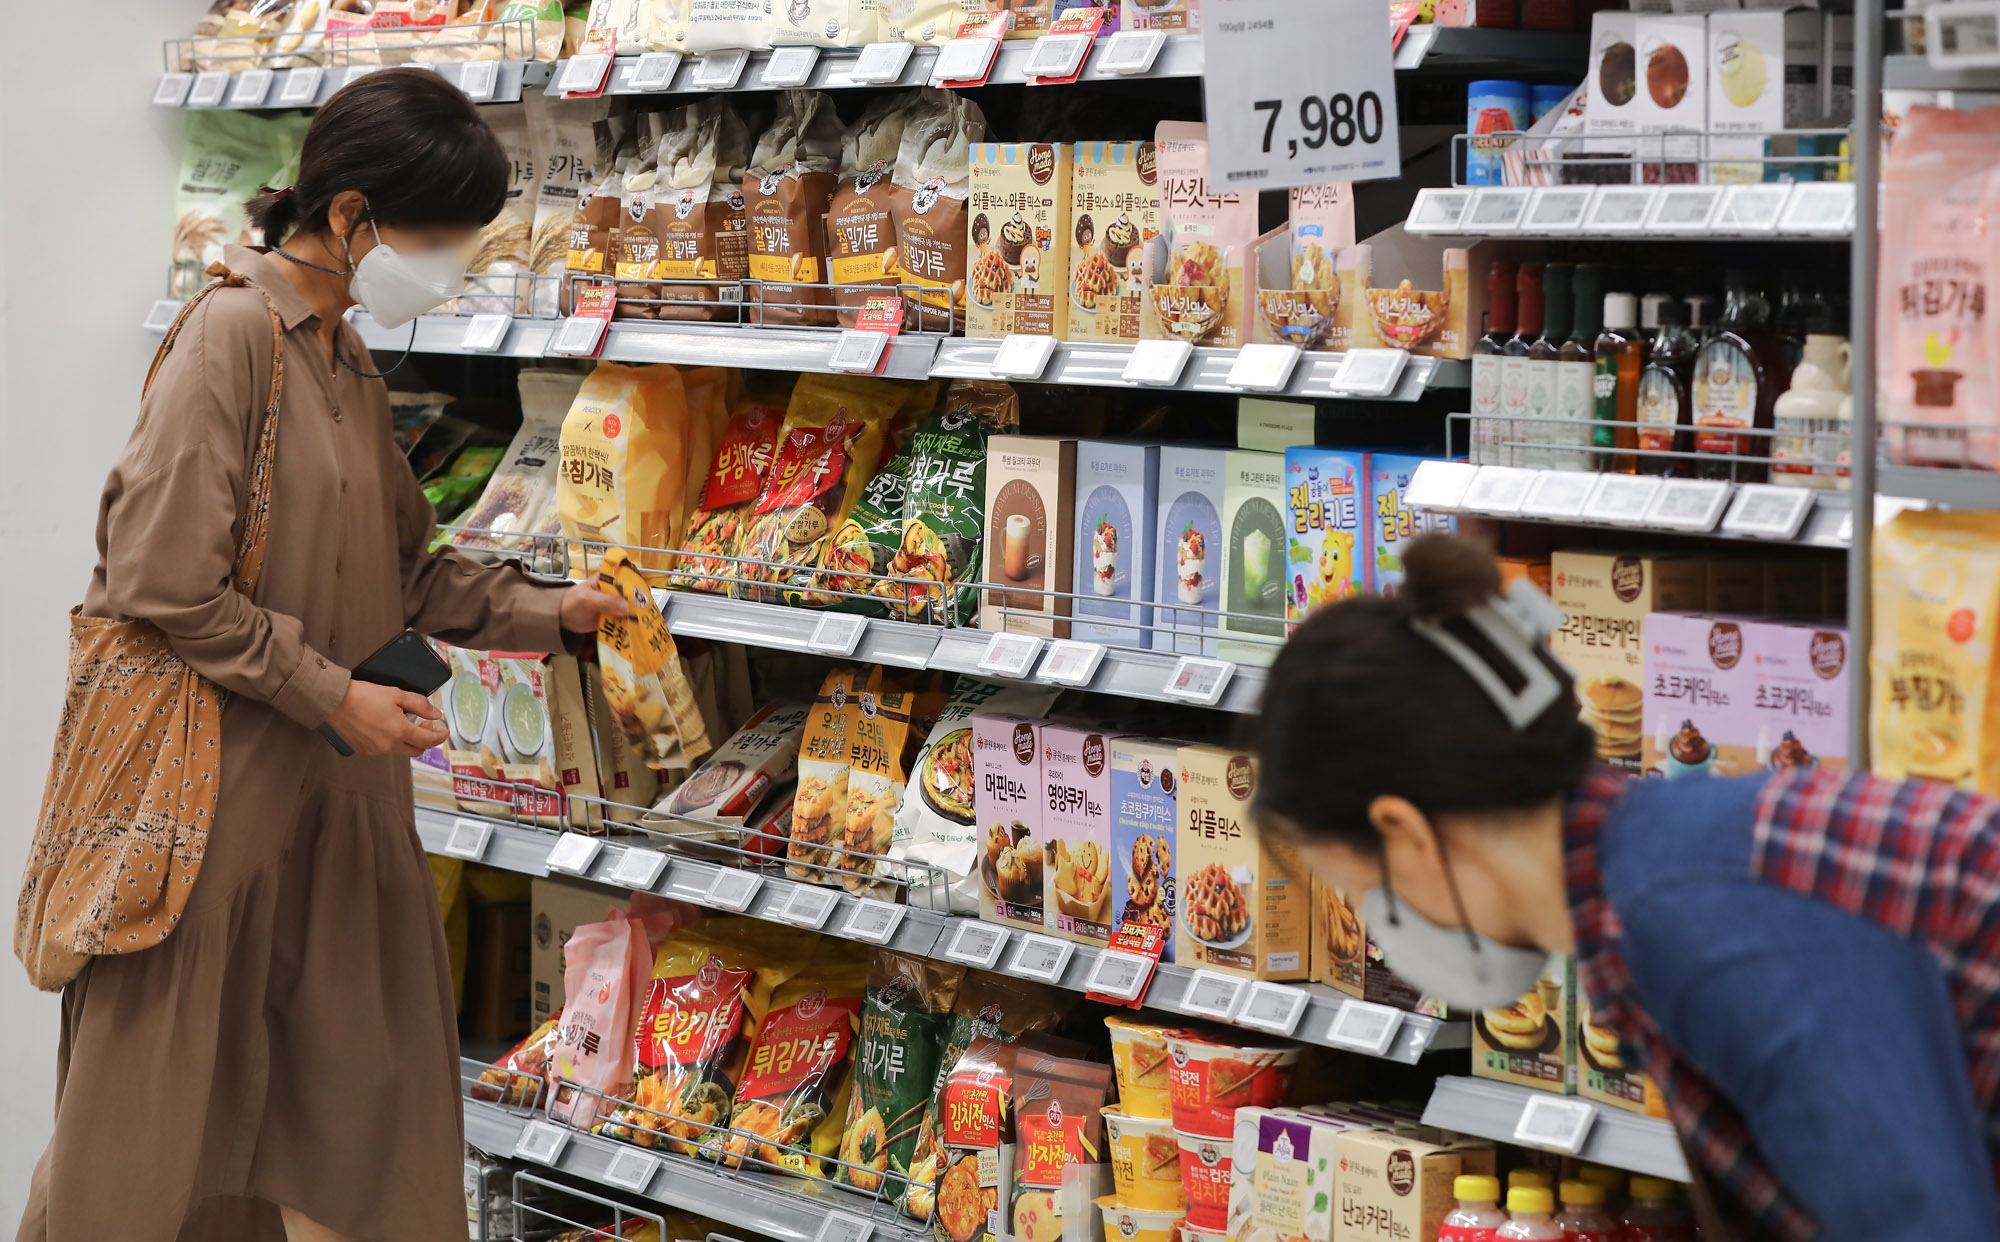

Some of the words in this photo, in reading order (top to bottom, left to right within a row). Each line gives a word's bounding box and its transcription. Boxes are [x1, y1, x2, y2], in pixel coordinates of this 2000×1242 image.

[1254, 91, 1383, 159] 7,980
[1030, 145, 1052, 165] Home
[1033, 158, 1052, 172] made
[1138, 147, 1156, 166] Hom
[972, 192, 1003, 211] 와플믹스
[1008, 192, 1041, 211] 와플믹스
[1076, 192, 1109, 211] 와플믹스
[1115, 193, 1149, 211] 와플믹스
[1034, 211, 1048, 223] 세트
[1142, 211, 1155, 224] 세트
[754, 226, 790, 253] 찰밀가루
[836, 223, 879, 253] 찰밀가루
[902, 241, 946, 278] 찰밀가루
[1160, 295, 1211, 320] 비스킷믹스
[1266, 298, 1319, 321] 비스킷믹스
[1378, 295, 1432, 321] 비스킷믹스
[714, 441, 773, 486] 부침가루
[1002, 455, 1012, 466] 투썸
[1012, 455, 1026, 467] 밀크티
[1026, 456, 1041, 468] 파우더
[1091, 460, 1100, 471] 투썸
[1112, 462, 1127, 474] 파우더
[1200, 468, 1216, 479] 파우더
[1240, 470, 1251, 482] 투썸
[1251, 471, 1265, 484] 그린티
[1265, 473, 1281, 485] 파우더
[1289, 481, 1357, 534] 젤리키트
[796, 529, 809, 538] 사용
[1557, 613, 1641, 651] 우리밀팬케익
[731, 730, 777, 749] 부침가루
[854, 717, 882, 746] 우리밀
[1014, 729, 1033, 745] Home
[806, 732, 845, 757] 부침가루
[984, 738, 993, 751] 큐원
[992, 741, 1007, 752] 홈메이드
[1017, 739, 1033, 752] made
[1083, 741, 1102, 757] Home
[848, 740, 887, 772] 부침가루
[1052, 749, 1062, 761] 큐원
[1062, 753, 1077, 764] 홈메이드
[1087, 751, 1102, 764] made
[1048, 769, 1064, 782] 우리아이
[1190, 772, 1201, 785] 큐원
[455, 779, 496, 800] 식혜만들기
[985, 773, 1027, 803] 머핀믹스
[1047, 783, 1102, 818] 영양쿠키믹스
[1120, 799, 1172, 823] 초코칩쿠키믹스
[1189, 808, 1241, 841] 와플믹스
[651, 1003, 731, 1047] 튀김가루
[752, 1031, 840, 1079] 튀김가루
[1179, 1069, 1200, 1087] 컵전
[949, 1101, 996, 1132] 김치전믹스
[1049, 1112, 1061, 1121] 오뚜기
[1046, 1129, 1065, 1142] 초간편
[1027, 1144, 1079, 1171] 감자전믹스
[1349, 1160, 1360, 1173] 큐원
[1113, 1159, 1134, 1182] 자전
[1342, 1196, 1410, 1240] 난과커리믹스
